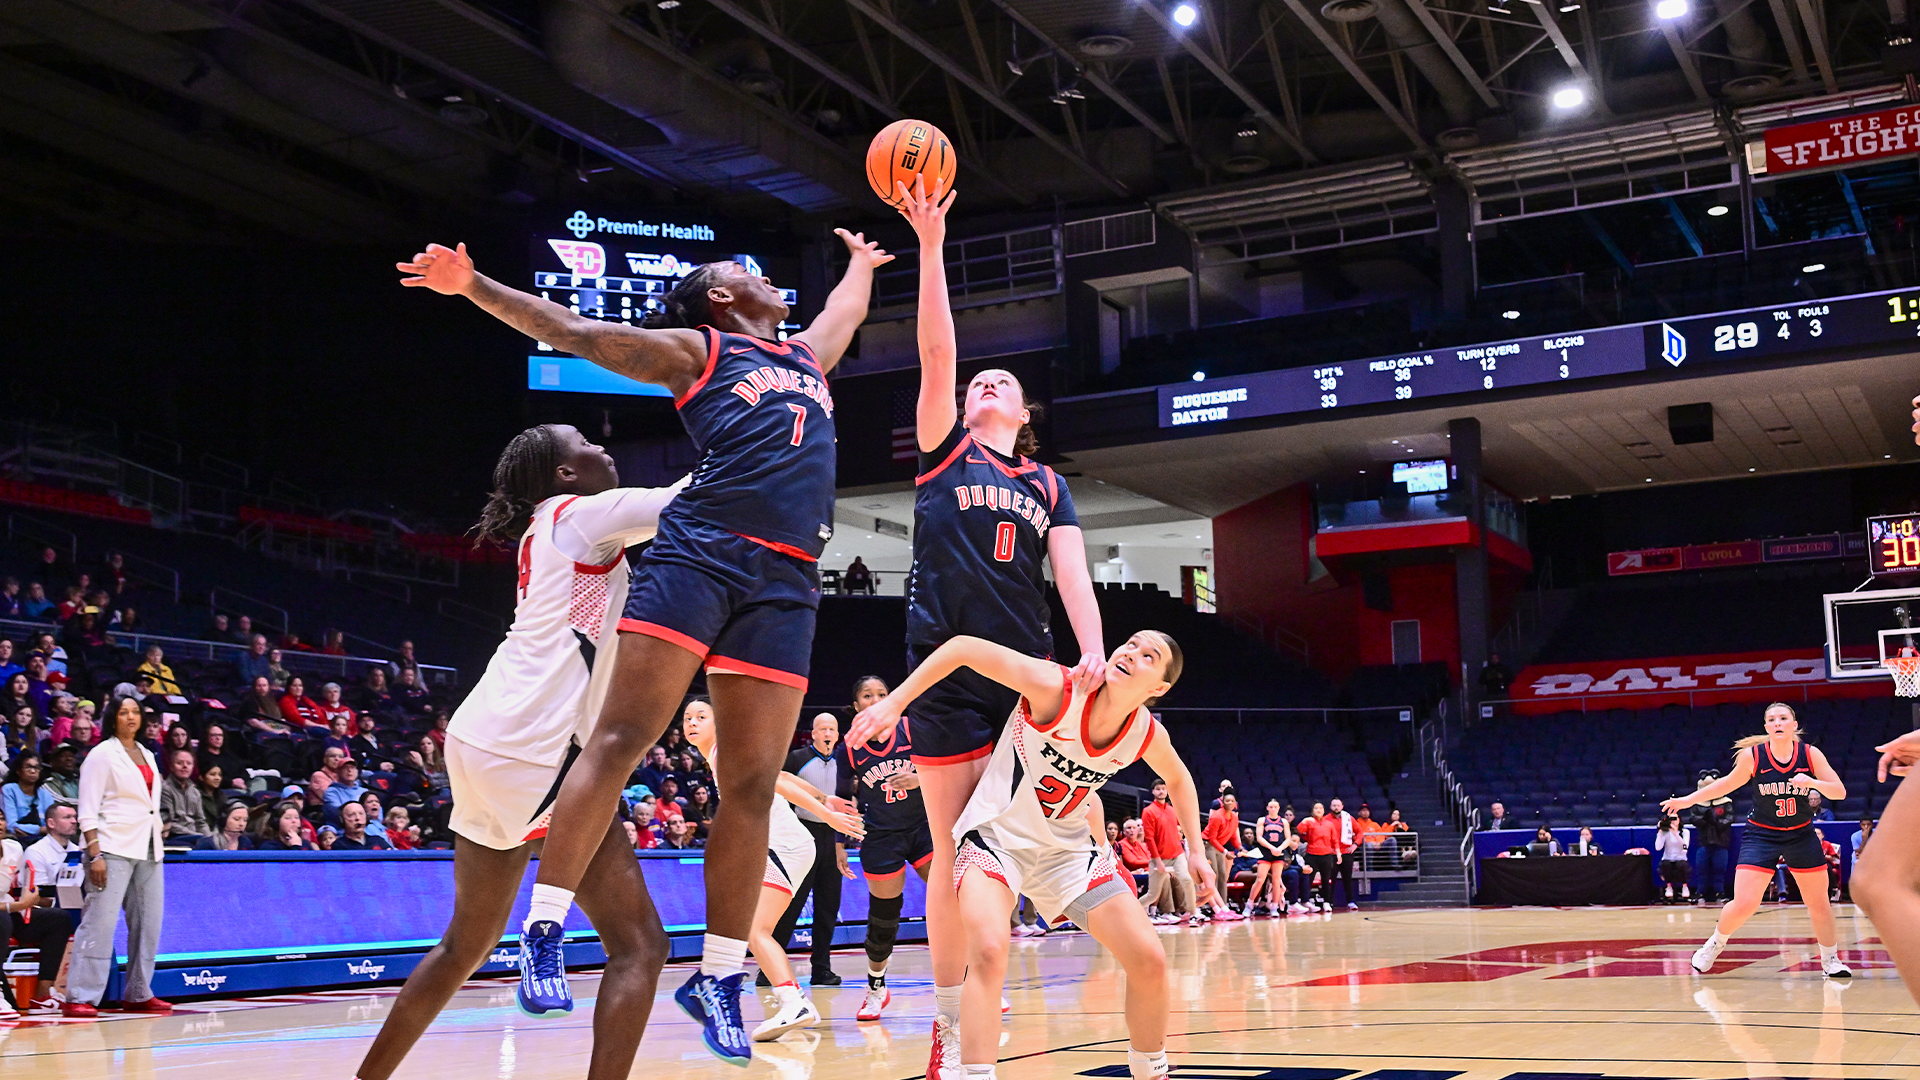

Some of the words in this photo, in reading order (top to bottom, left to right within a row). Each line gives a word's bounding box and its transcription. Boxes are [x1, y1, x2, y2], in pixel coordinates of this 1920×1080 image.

[1830, 116, 1880, 136] THE
[901, 126, 927, 170] ELITE
[597, 217, 660, 237] Premier
[661, 222, 714, 242] Health
[621, 280, 632, 292] A
[646, 281, 656, 293] F
[1773, 311, 1791, 322] TOL
[1798, 306, 1829, 322] FOULS
[1543, 335, 1584, 350] BLOCKS
[1714, 322, 1758, 352] 29
[1777, 323, 1790, 340] 4
[1809, 319, 1822, 341] 3
[1457, 349, 1484, 361] TURN
[1486, 343, 1520, 357] OVERS
[1313, 369, 1320, 379] 3
[1321, 367, 1333, 377] PT
[1370, 360, 1396, 372] FIELD
[1397, 357, 1423, 369] GOAL
[1424, 355, 1433, 365] %
[1173, 388, 1247, 409] DUQUESNE
[1320, 377, 1336, 391] 39
[1395, 368, 1411, 382] 36
[1480, 357, 1496, 371] 12
[1560, 348, 1568, 362] 1
[1172, 406, 1228, 425] DAYTON
[1321, 393, 1337, 408] 33
[1395, 385, 1412, 400] 39
[1483, 375, 1493, 389] 8
[1559, 364, 1569, 379] 3
[786, 403, 807, 446] 7
[955, 485, 1050, 538] DUQUESNE
[994, 521, 1016, 562] 0
[1770, 541, 1833, 555] RICHMOND
[1701, 549, 1741, 561] LOYOLA
[1882, 537, 1920, 567] 30
[1034, 775, 1090, 820] 21
[1775, 797, 1797, 817] 30
[360, 960, 385, 980] Kroger
[196, 970, 227, 991] Kroger
